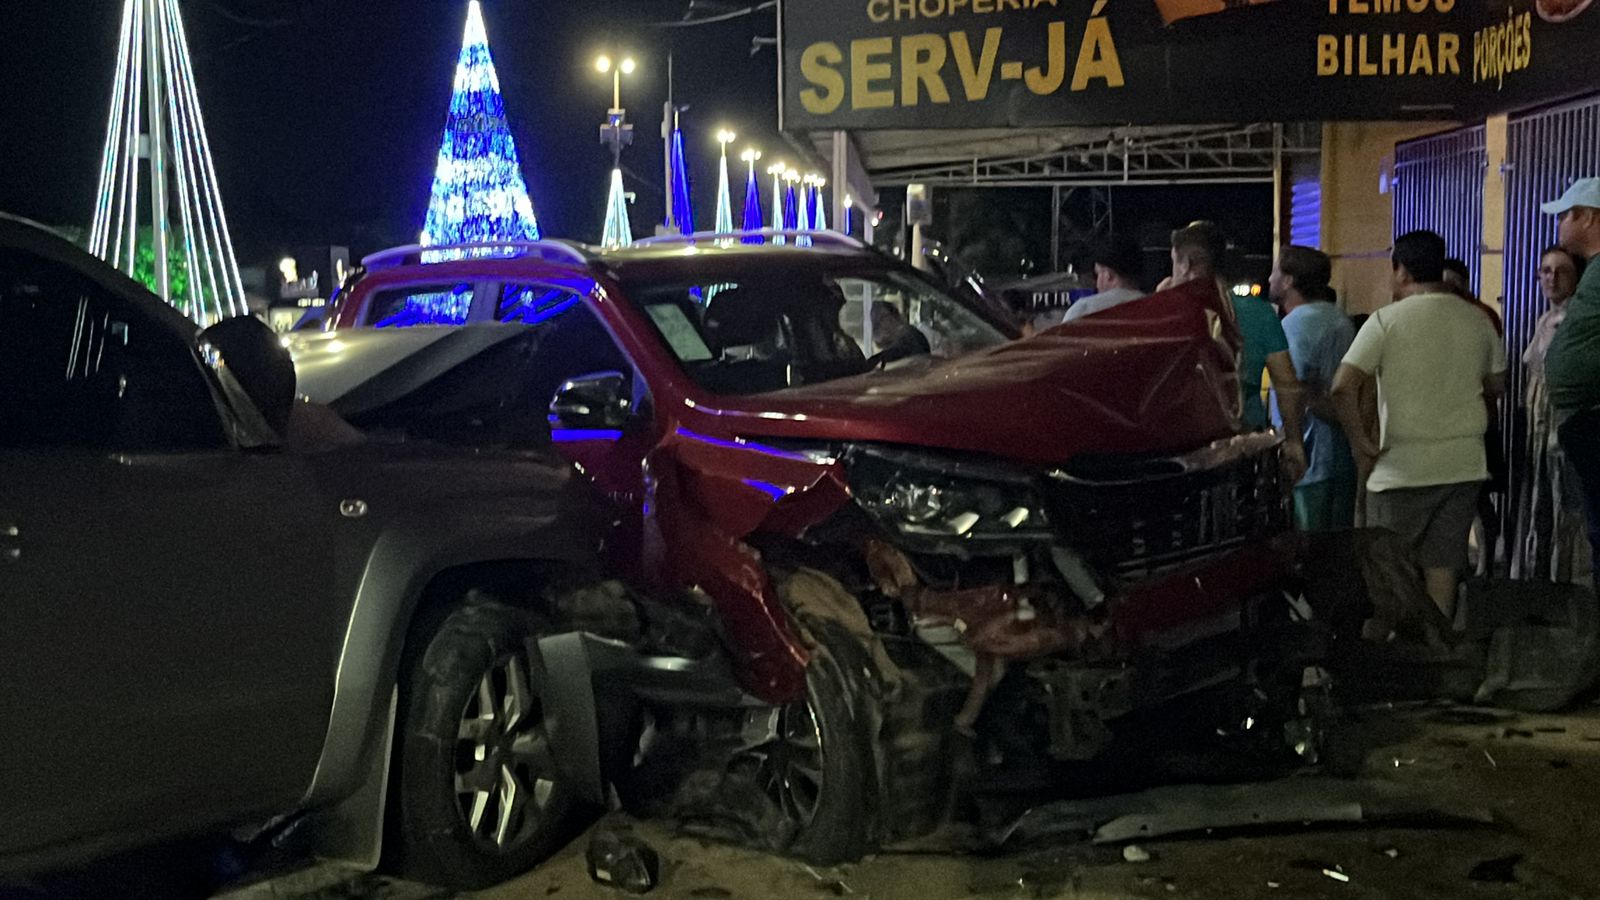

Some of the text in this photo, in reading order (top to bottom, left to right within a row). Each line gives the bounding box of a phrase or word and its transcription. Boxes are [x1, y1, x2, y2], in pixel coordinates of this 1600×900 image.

[866, 0, 1058, 23] CHOPE
[800, 0, 1124, 114] SERV-JÁ
[1317, 33, 1460, 76] BILHAR
